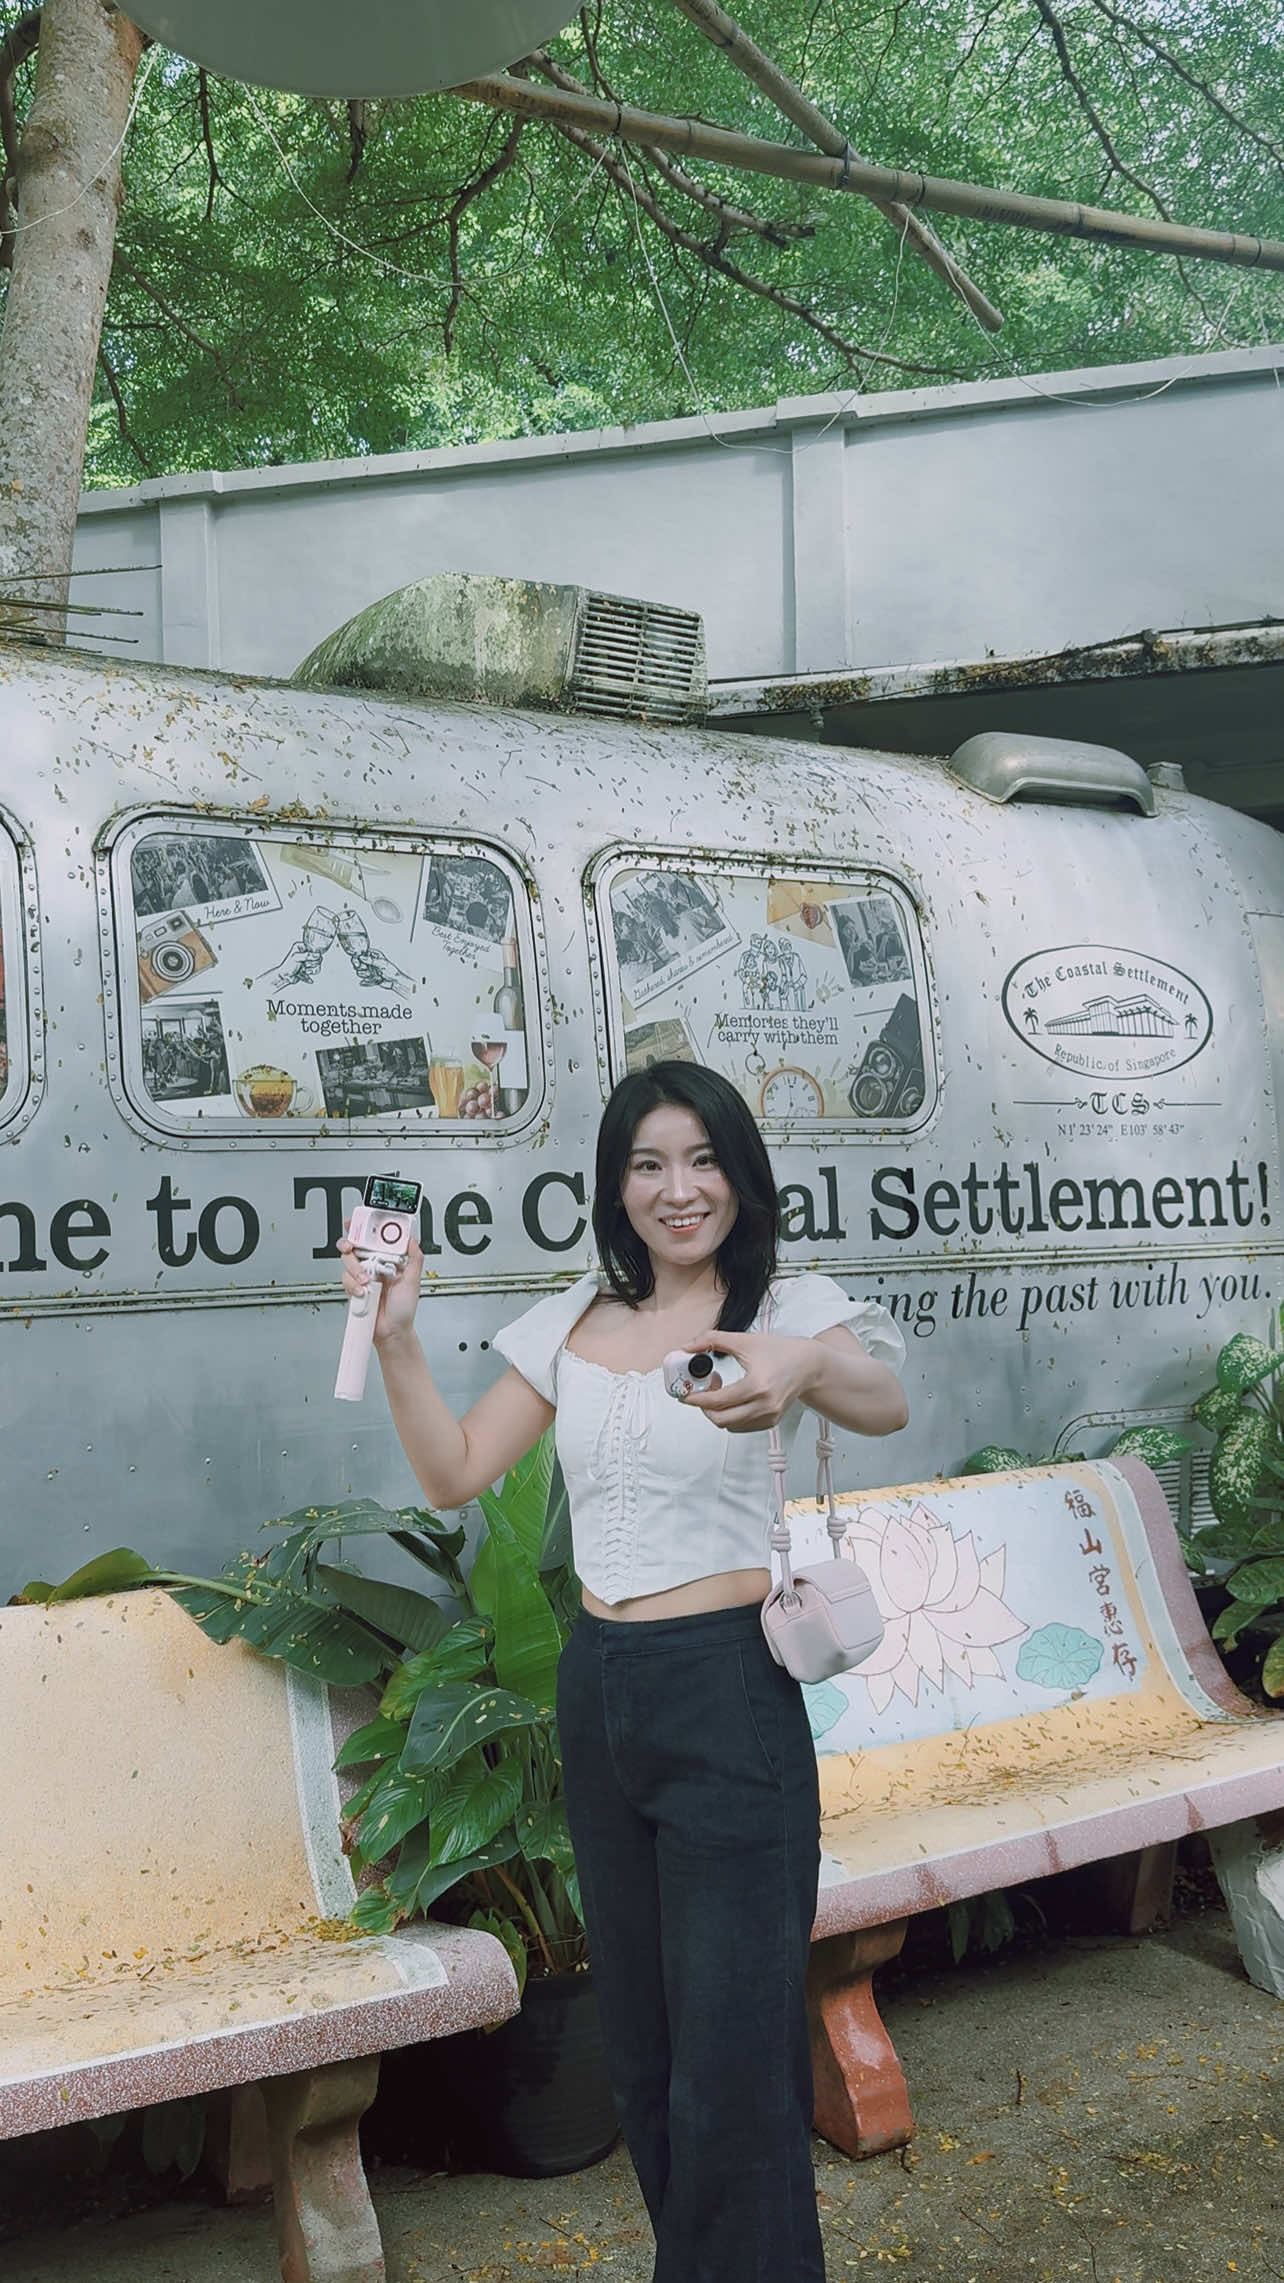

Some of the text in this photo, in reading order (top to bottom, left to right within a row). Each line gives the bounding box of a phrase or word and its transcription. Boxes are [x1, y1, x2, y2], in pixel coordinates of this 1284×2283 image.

[204, 896, 270, 919] Here & Now
[1024, 961, 1190, 1005] The Coastal Settlement
[266, 1000, 413, 1019] Moments made
[300, 1018, 382, 1037] together
[714, 1013, 840, 1032] Memories they'll
[718, 1030, 839, 1045] carry with them
[1054, 1043, 1177, 1072] Republic of Singapore
[1089, 1091, 1151, 1115] TCS
[146, 1175, 260, 1268] to
[870, 1159, 1271, 1242] Settlement!
[951, 1272, 1008, 1319] the
[1016, 1273, 1098, 1331] past
[1112, 1262, 1190, 1309] with
[1197, 1270, 1272, 1319] you.
